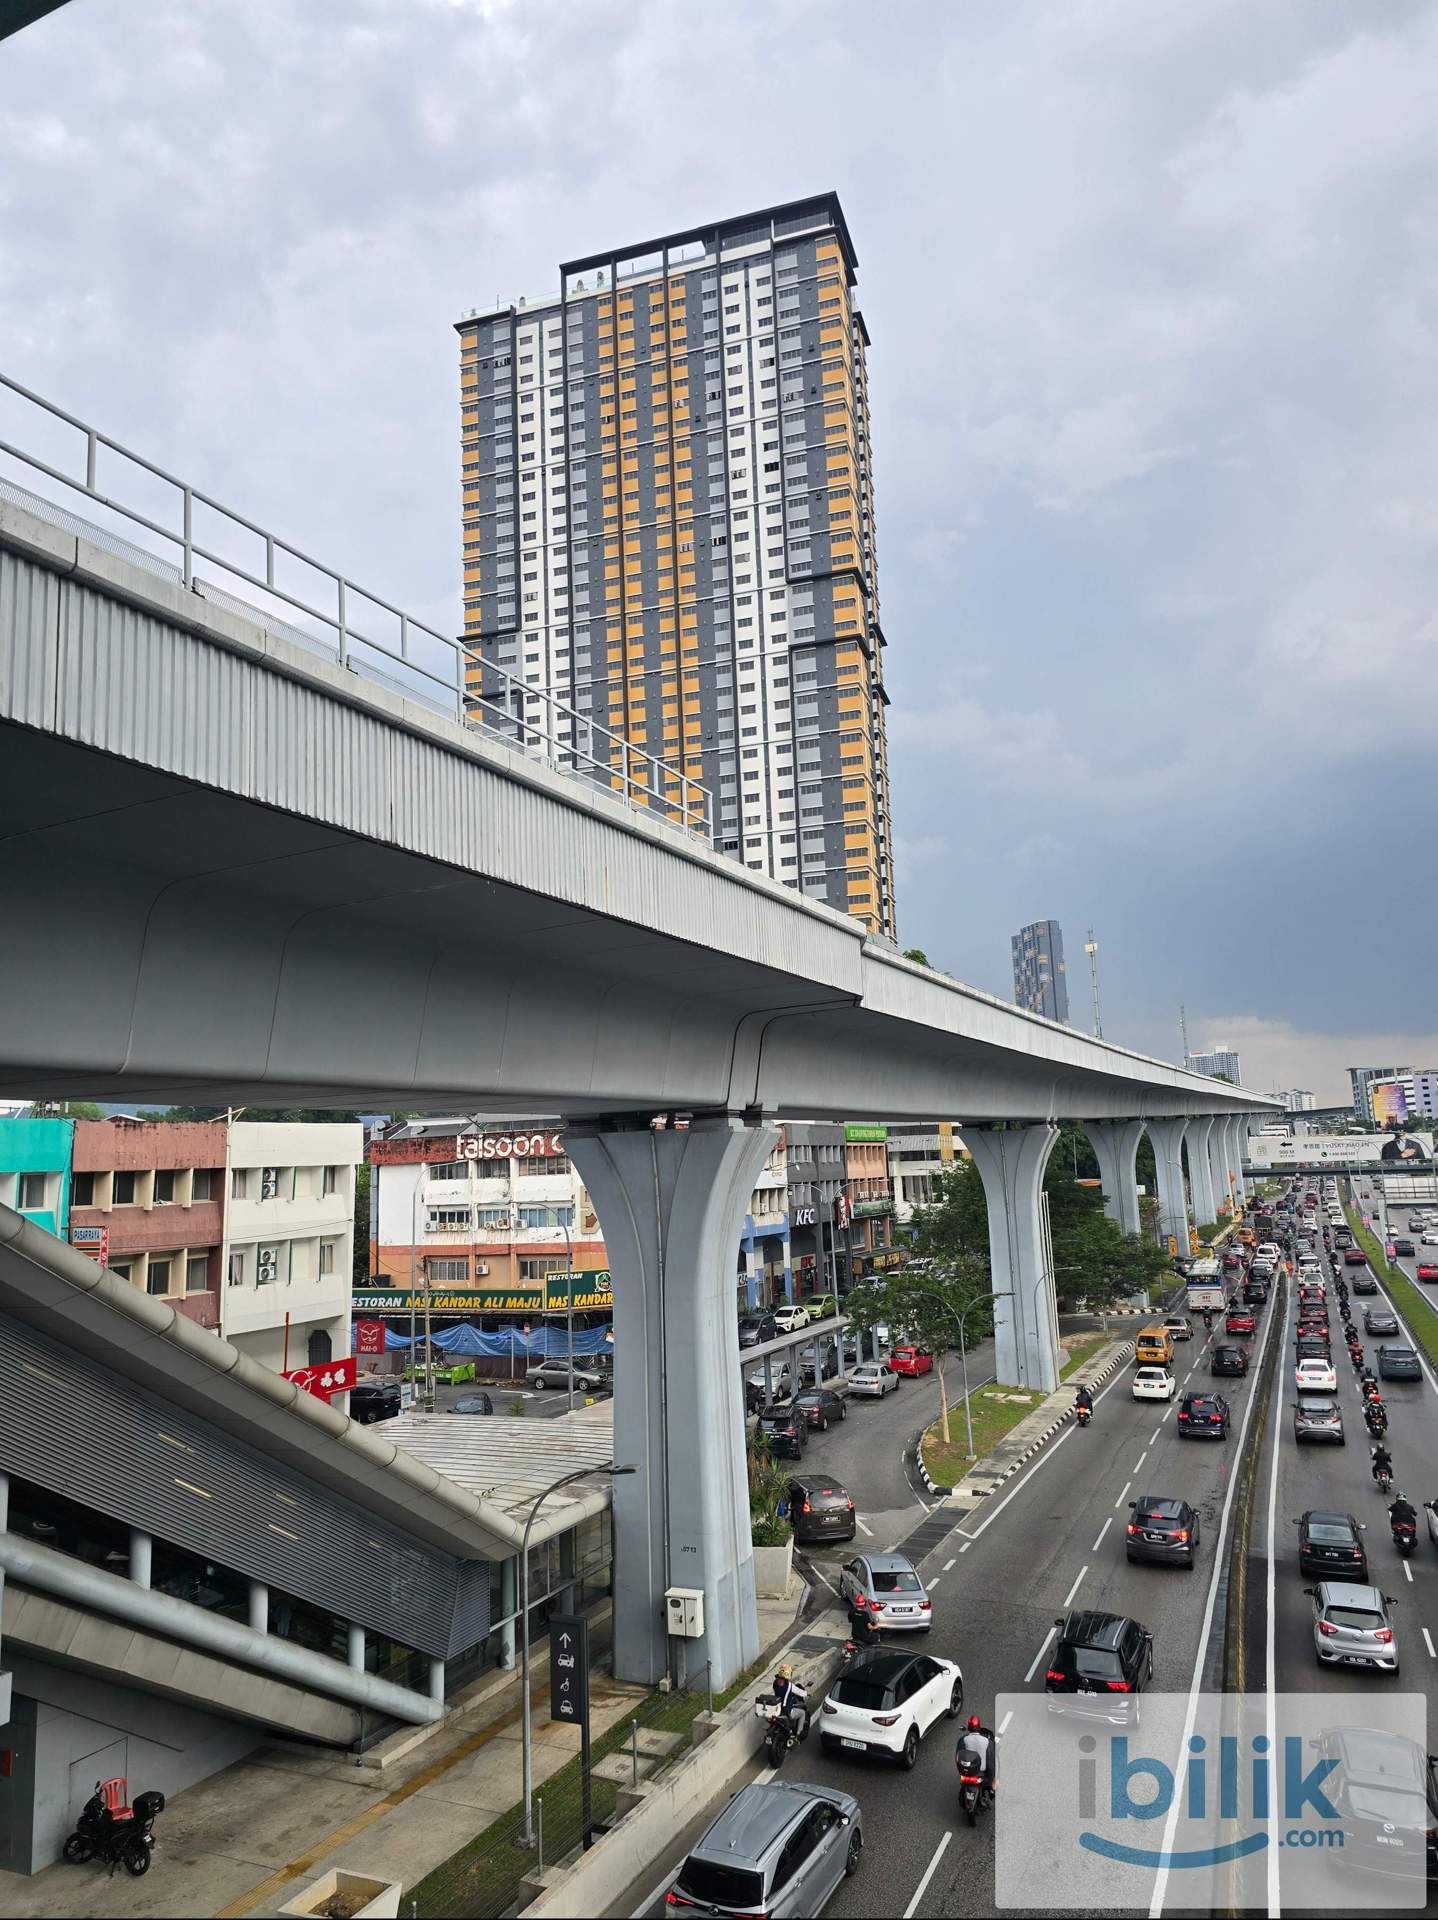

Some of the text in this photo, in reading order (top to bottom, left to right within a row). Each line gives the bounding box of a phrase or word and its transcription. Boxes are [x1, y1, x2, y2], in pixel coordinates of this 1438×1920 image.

[796, 1208, 815, 1226] KFC
[352, 1297, 402, 1308] ESTORAN
[434, 1297, 481, 1308] KANDAR
[484, 1297, 503, 1308] ALI
[505, 1297, 541, 1309] MAJU
[548, 1292, 614, 1309] NAS KANDAR
